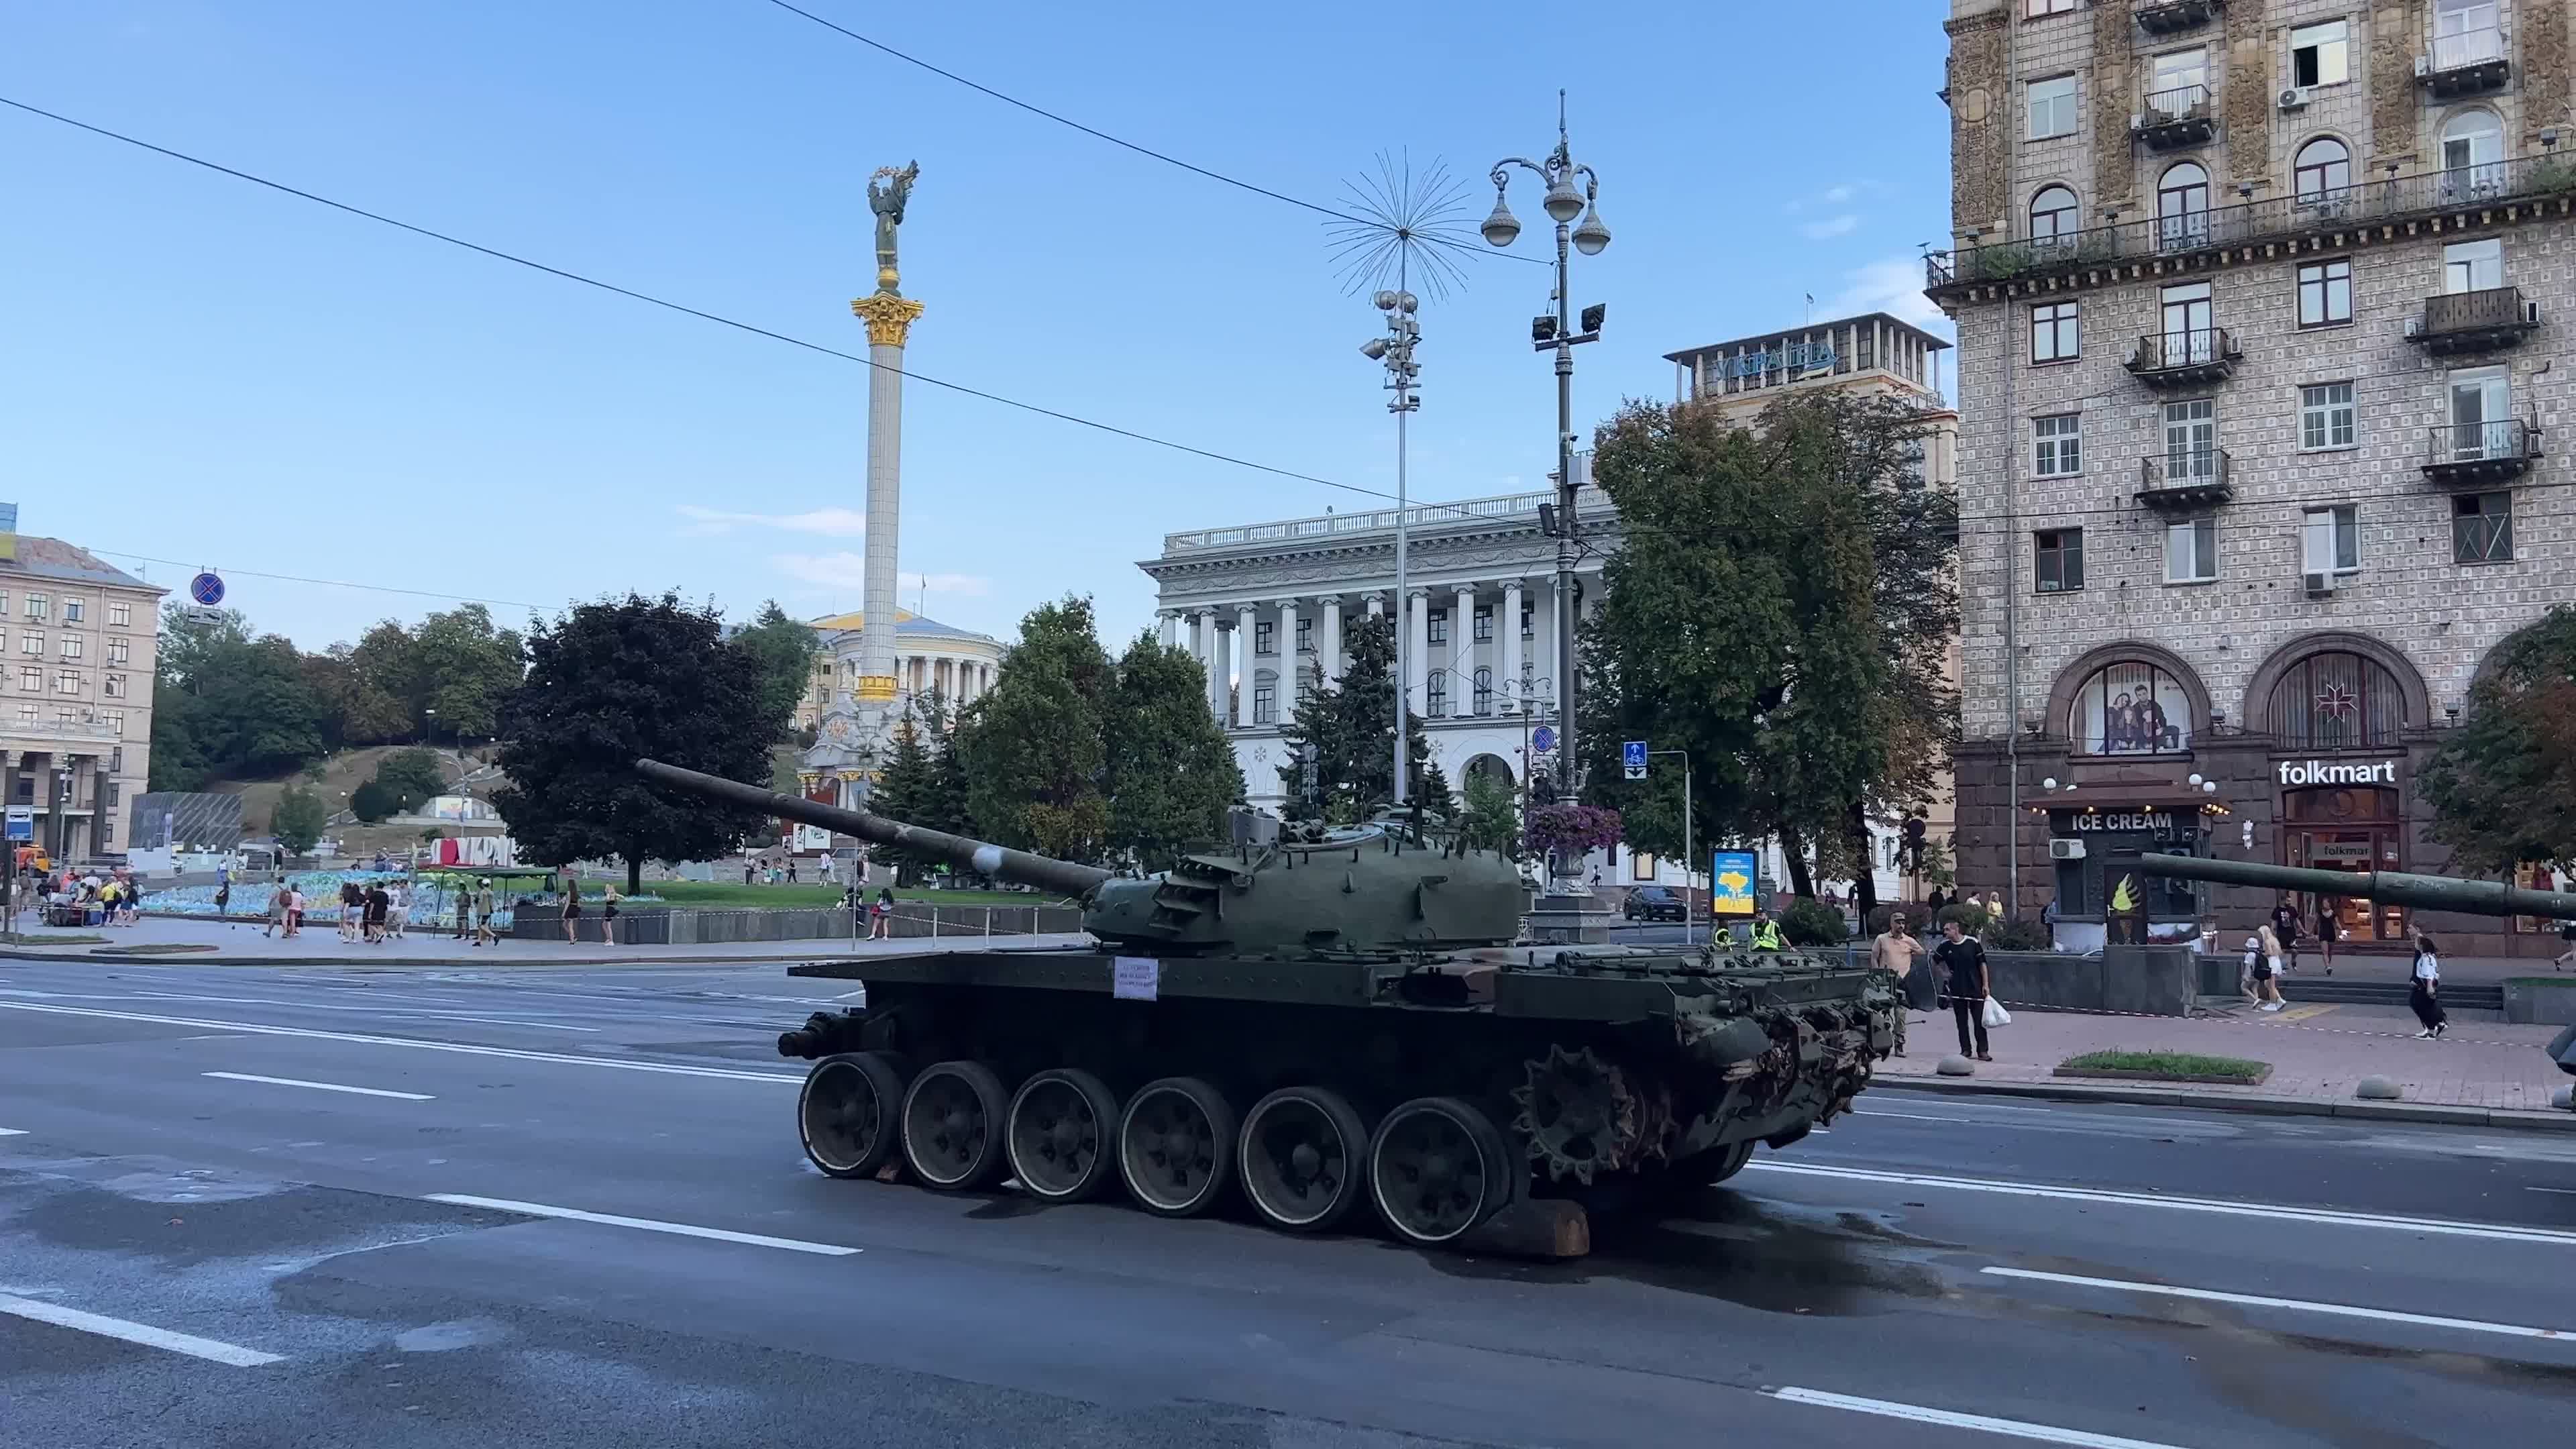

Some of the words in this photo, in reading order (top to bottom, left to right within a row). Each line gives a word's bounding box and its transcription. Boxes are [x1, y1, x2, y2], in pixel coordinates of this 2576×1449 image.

[2279, 760, 2395, 784] folkmart
[2072, 814, 2102, 830] ICE
[2106, 813, 2172, 830] CREAM
